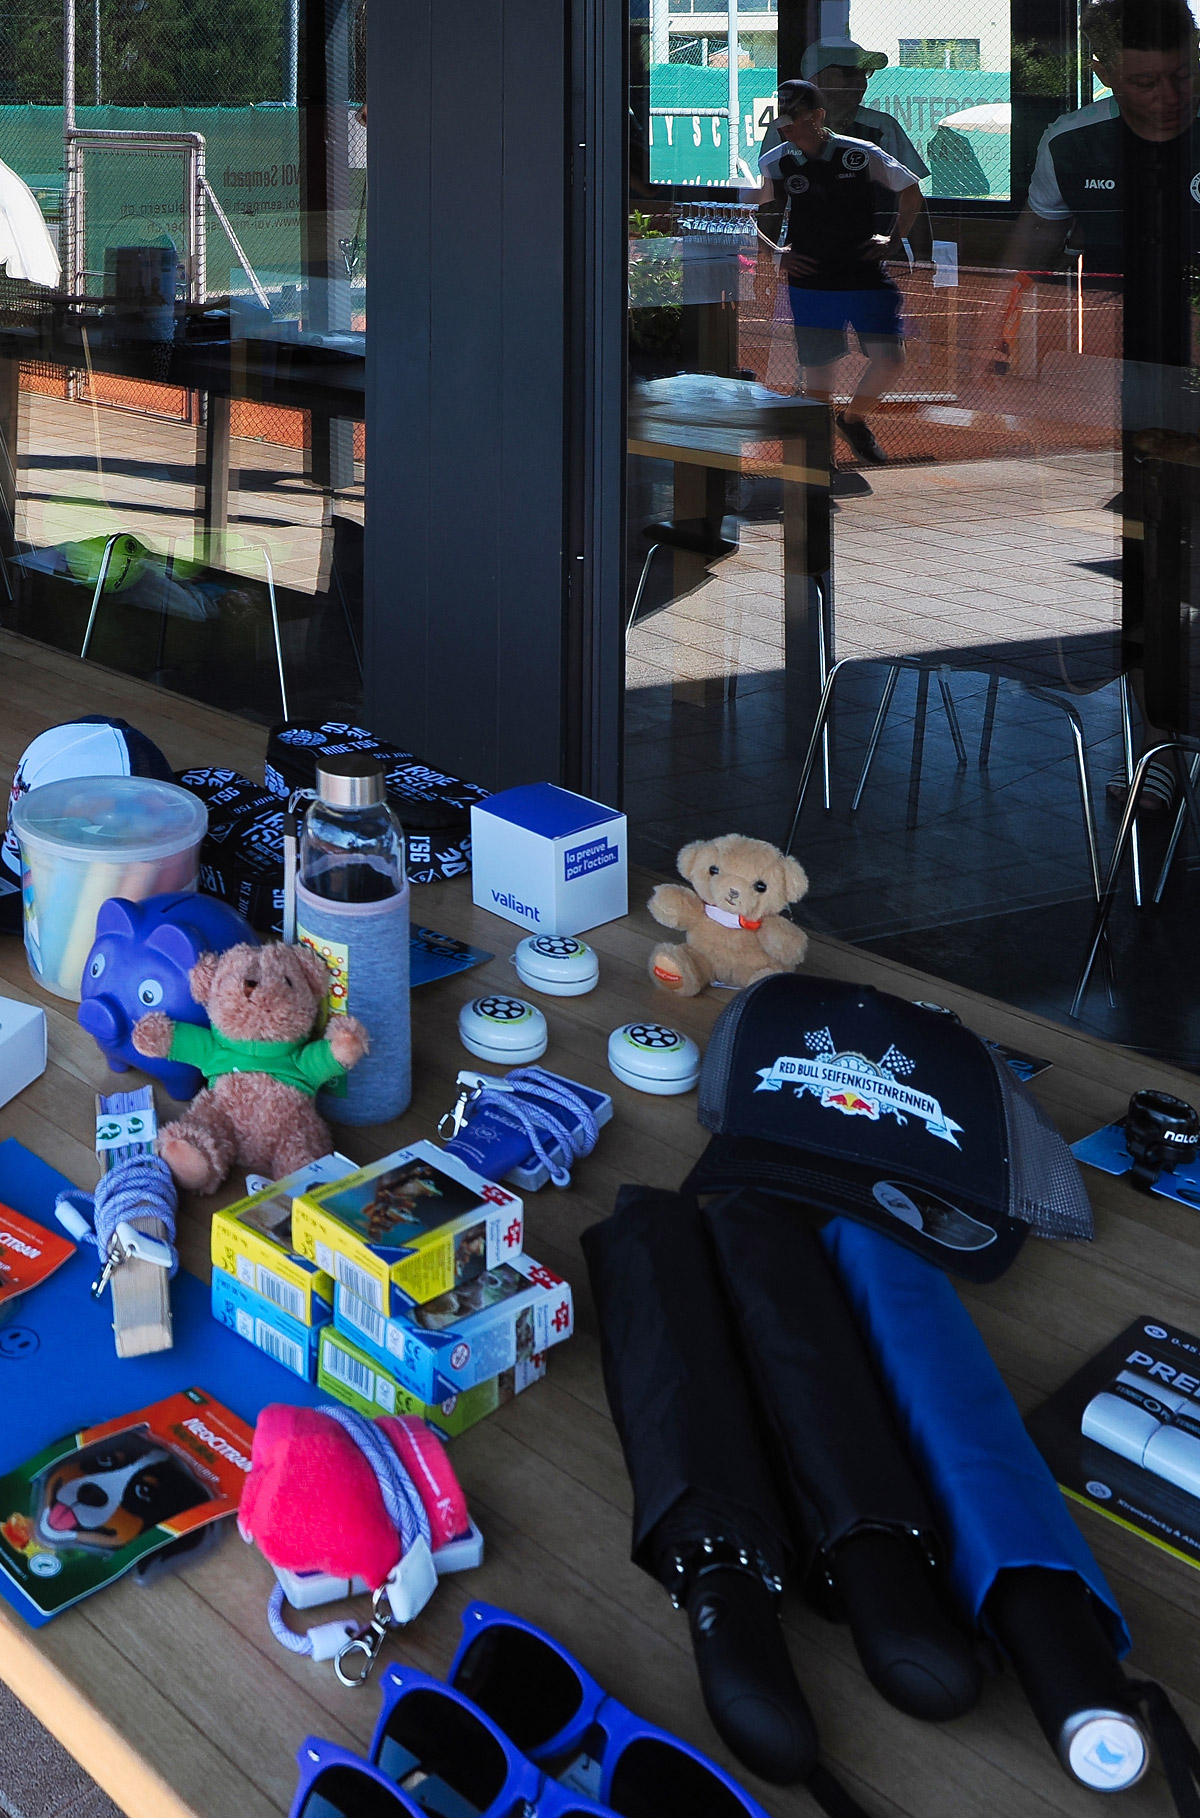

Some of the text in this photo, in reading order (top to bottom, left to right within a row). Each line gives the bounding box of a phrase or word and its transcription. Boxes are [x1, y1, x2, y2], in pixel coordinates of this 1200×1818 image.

[1084, 179, 1115, 190] JAKO
[566, 843, 606, 864] la preuve
[566, 853, 617, 879] par l'action.
[491, 889, 541, 923] valiant
[779, 1061, 935, 1115] RED BULL SEIFENKISTENRENNEN
[1125, 1350, 1200, 1398] PRE
